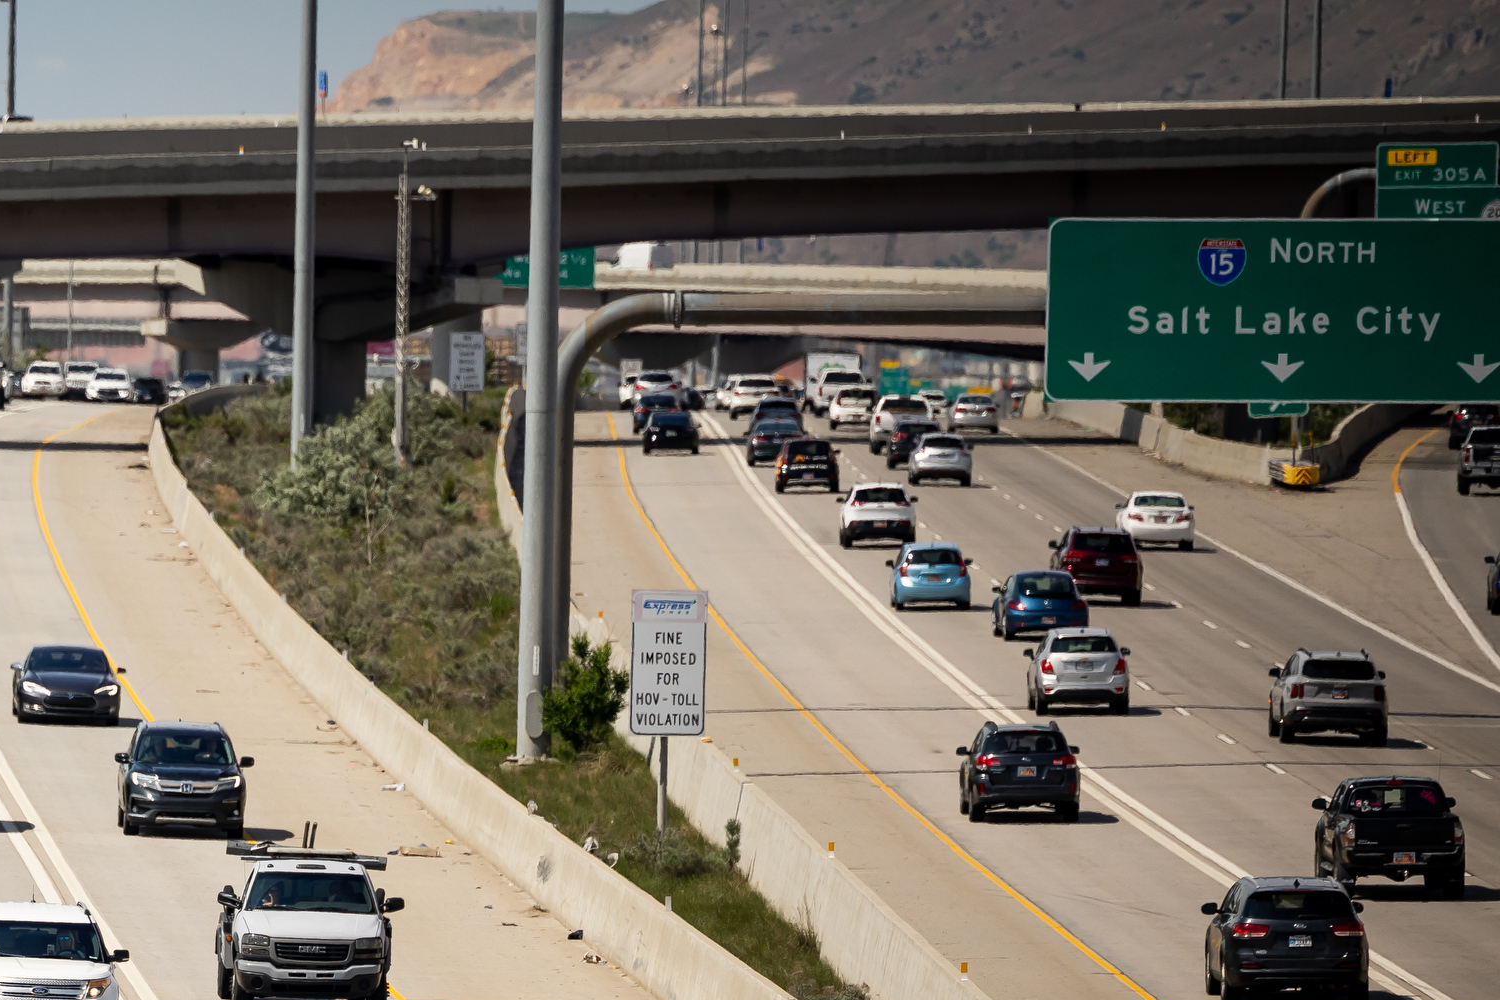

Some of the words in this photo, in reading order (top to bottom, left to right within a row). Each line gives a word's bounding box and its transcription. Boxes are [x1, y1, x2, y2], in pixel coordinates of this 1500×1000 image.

[1395, 151, 1430, 163] LEFT
[1395, 170, 1421, 180] EXIT
[1415, 198, 1466, 215] WEST
[1270, 238, 1376, 263] NORTH
[1210, 253, 1234, 275] 15
[1127, 305, 1211, 335] Salt
[1235, 306, 1330, 335] Lake
[1356, 306, 1441, 341] City
[643, 600, 691, 616] Express
[655, 632, 683, 645] FINE
[640, 652, 697, 665] IMPOSED
[656, 673, 680, 685] FOR
[636, 713, 700, 727] VIOLATION
